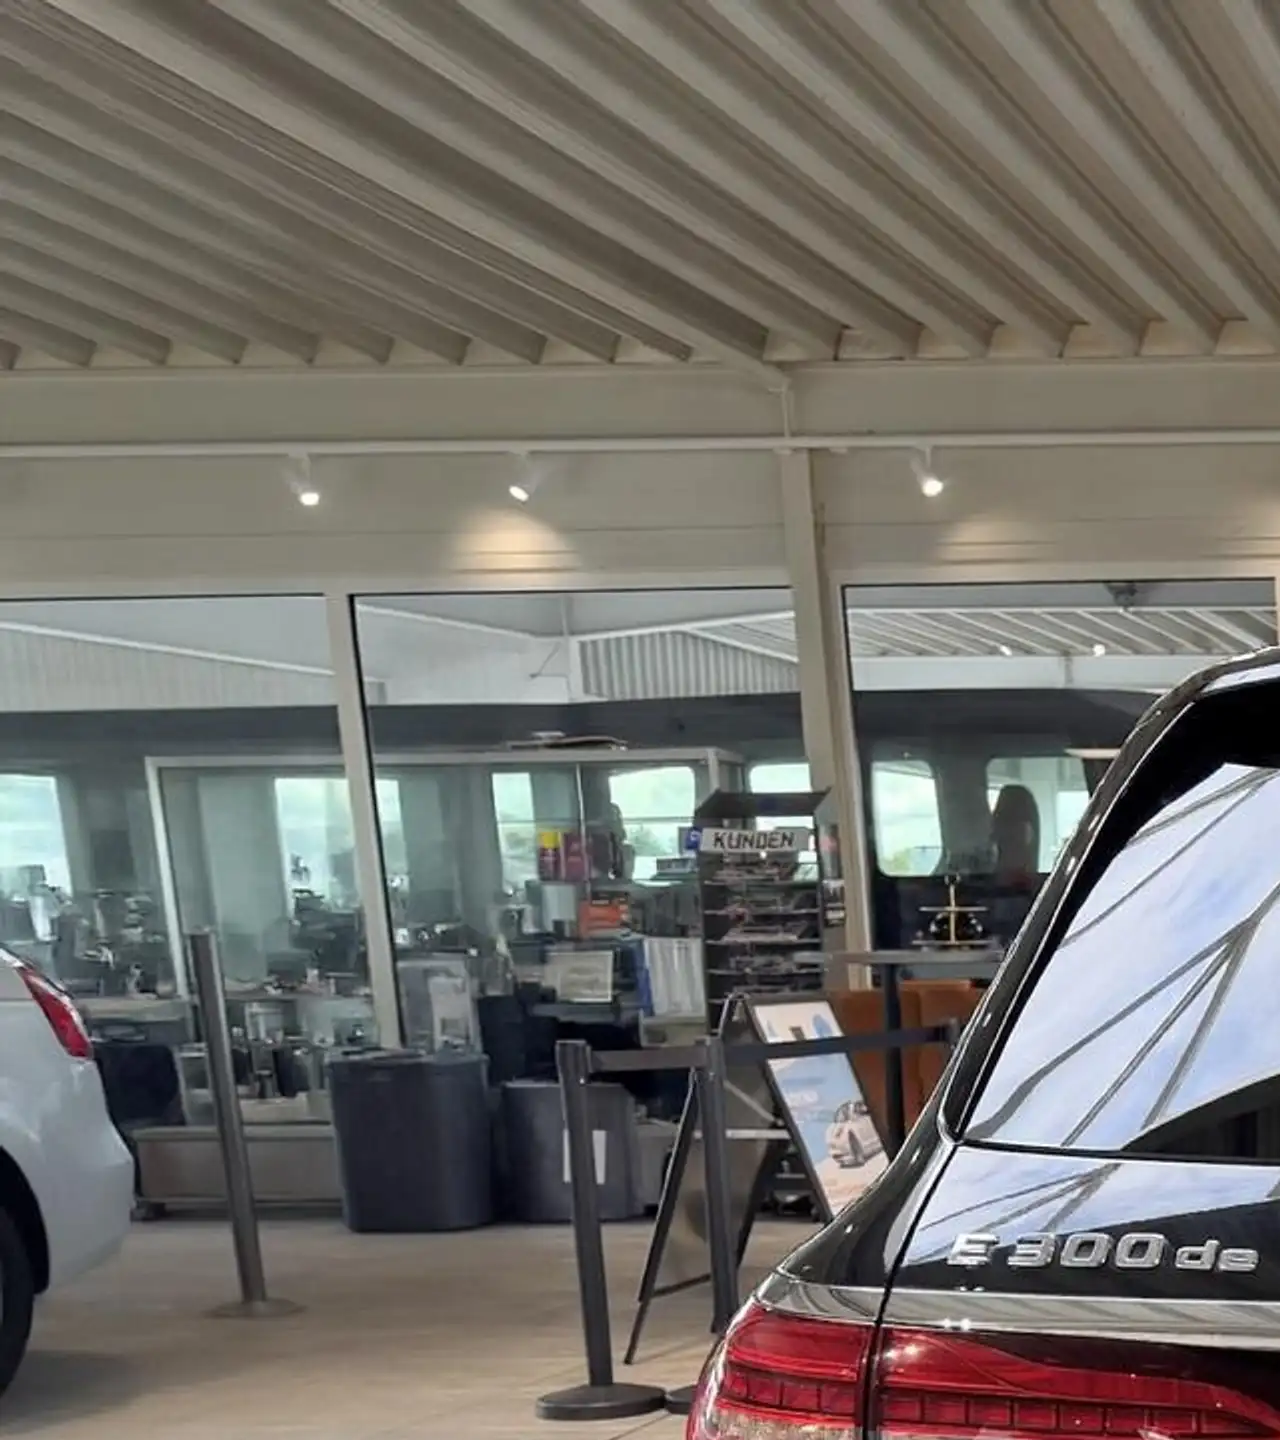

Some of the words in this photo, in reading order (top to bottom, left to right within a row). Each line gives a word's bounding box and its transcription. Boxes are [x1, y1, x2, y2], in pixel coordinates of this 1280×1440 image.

[713, 831, 796, 850] KUNDEN
[947, 1232, 999, 1267] E
[1007, 1231, 1170, 1270] 300
[1174, 1238, 1260, 1273] de
